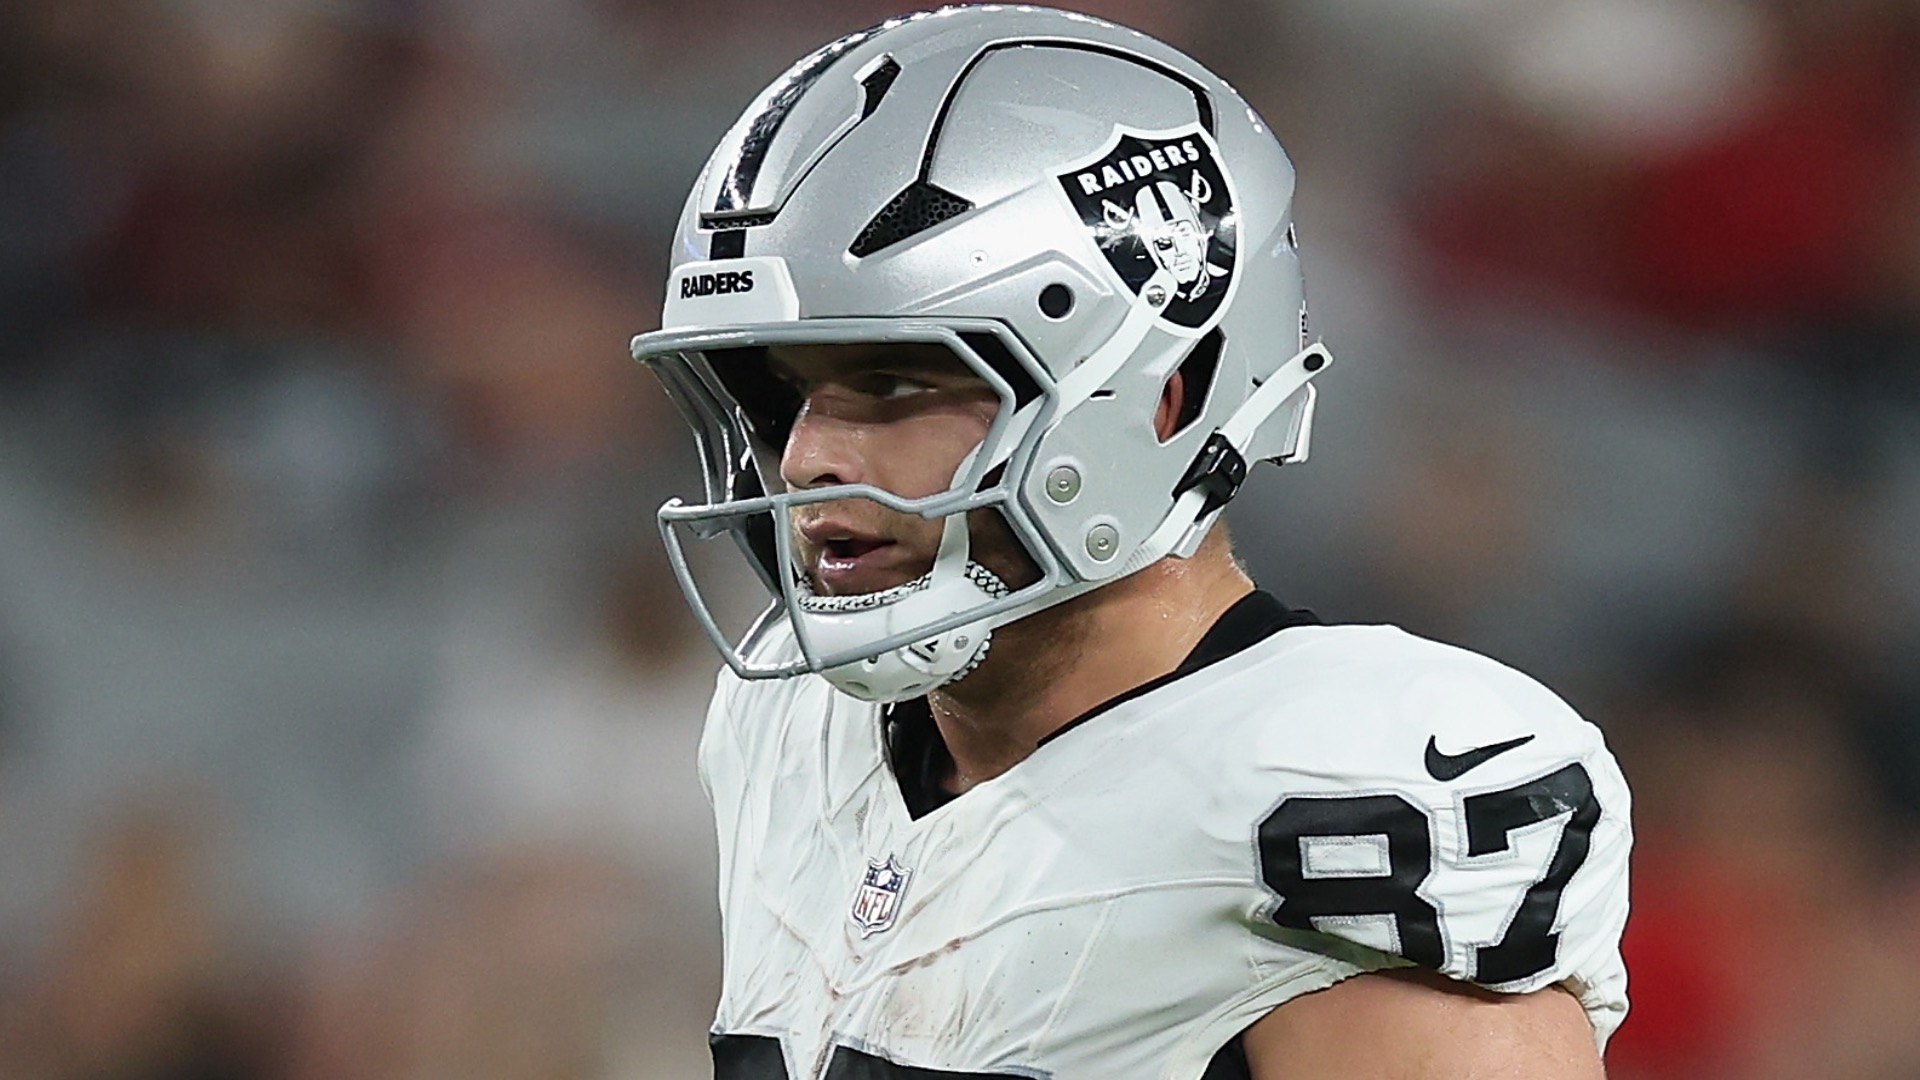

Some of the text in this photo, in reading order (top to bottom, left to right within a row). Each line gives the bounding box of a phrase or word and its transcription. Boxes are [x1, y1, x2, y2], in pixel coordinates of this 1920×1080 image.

[1077, 140, 1200, 196] RAIDERS
[681, 270, 754, 299] RAIDERS
[1257, 761, 1602, 985] 87
[856, 888, 891, 922] NFL
